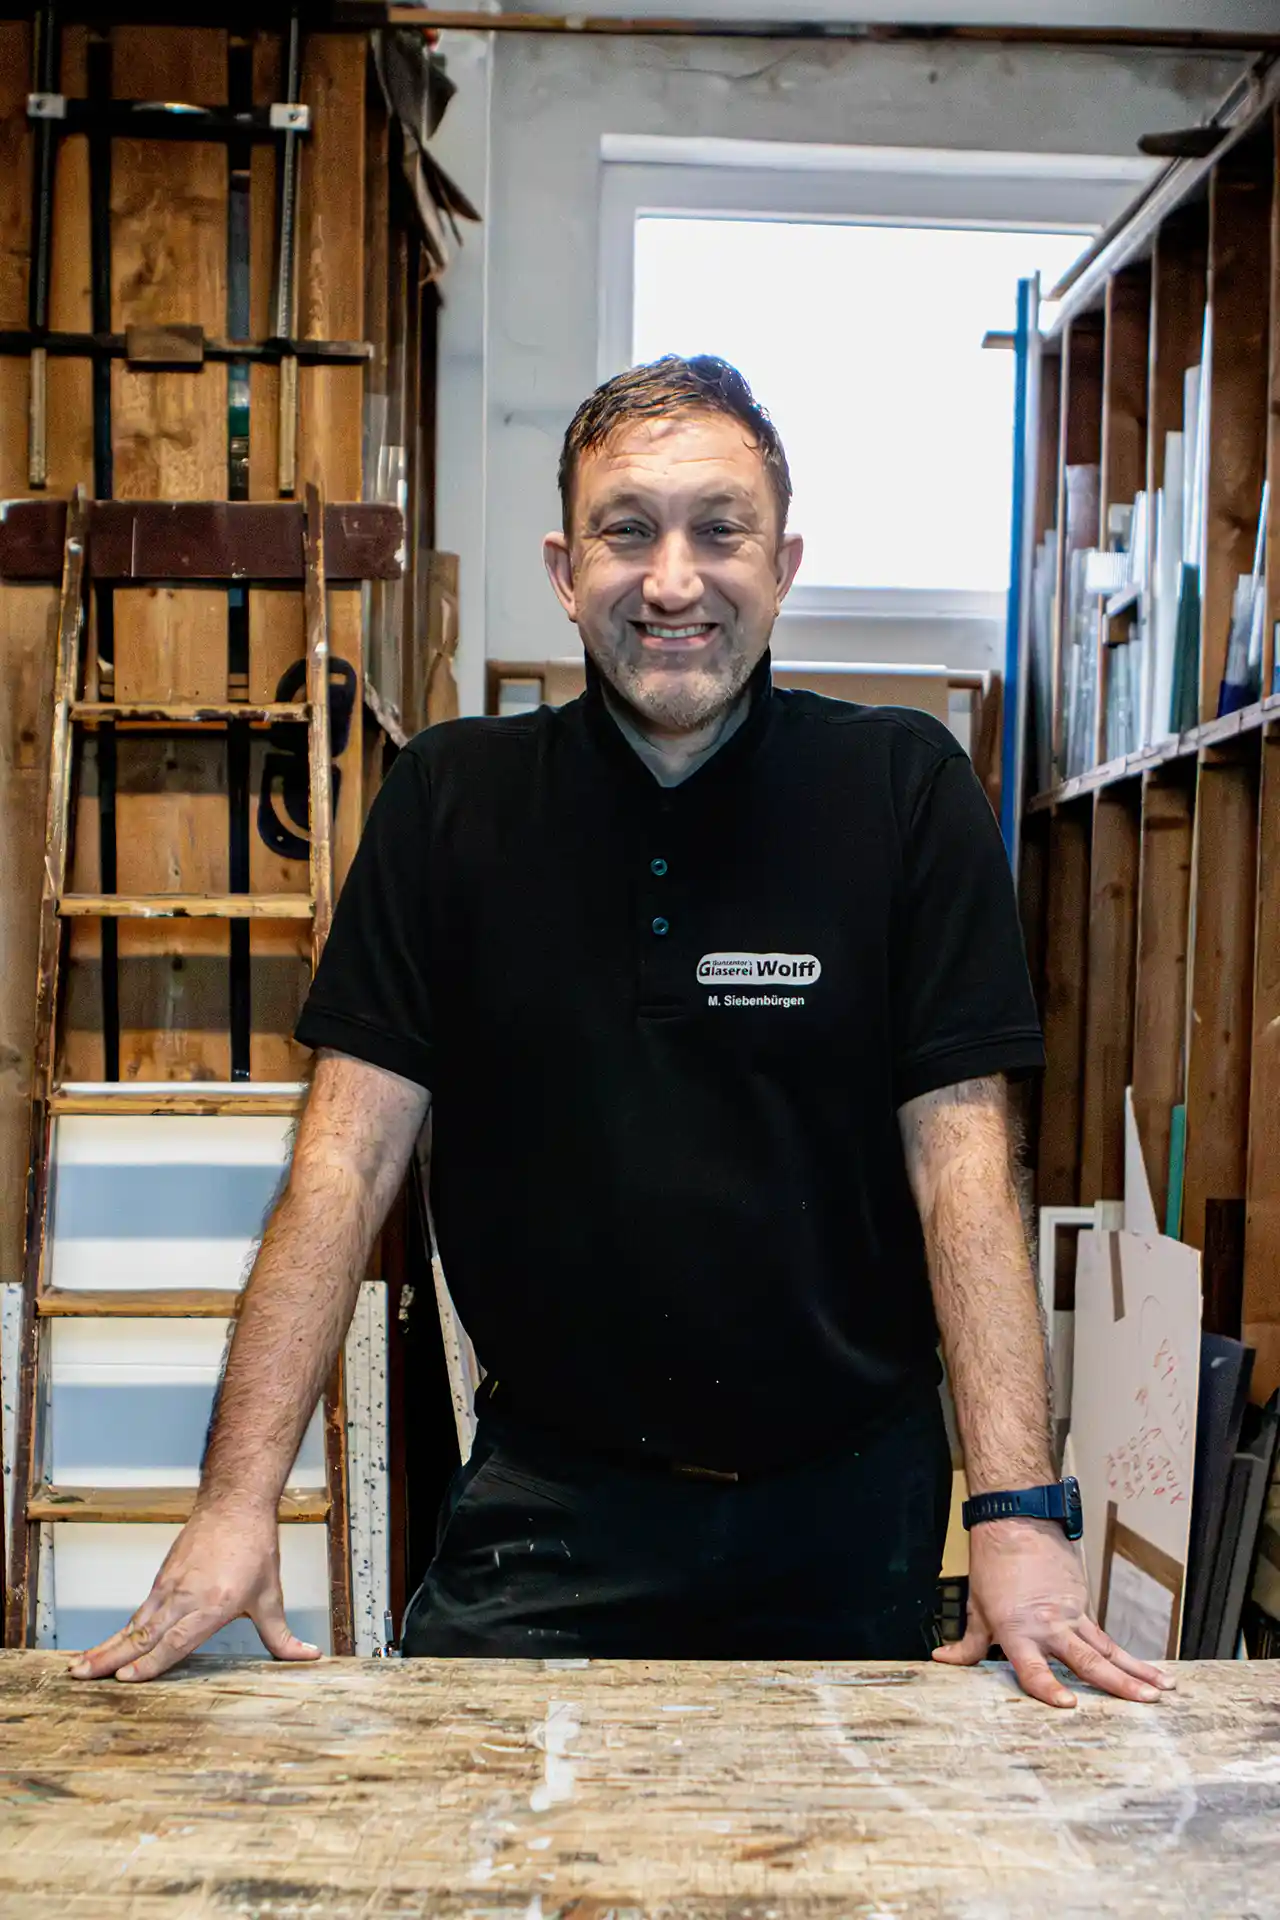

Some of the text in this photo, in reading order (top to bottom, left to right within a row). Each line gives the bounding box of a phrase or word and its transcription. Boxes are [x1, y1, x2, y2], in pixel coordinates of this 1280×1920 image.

[699, 961, 816, 977] Glaserei Wolff
[708, 995, 805, 1008] M. Siebenbürgen
